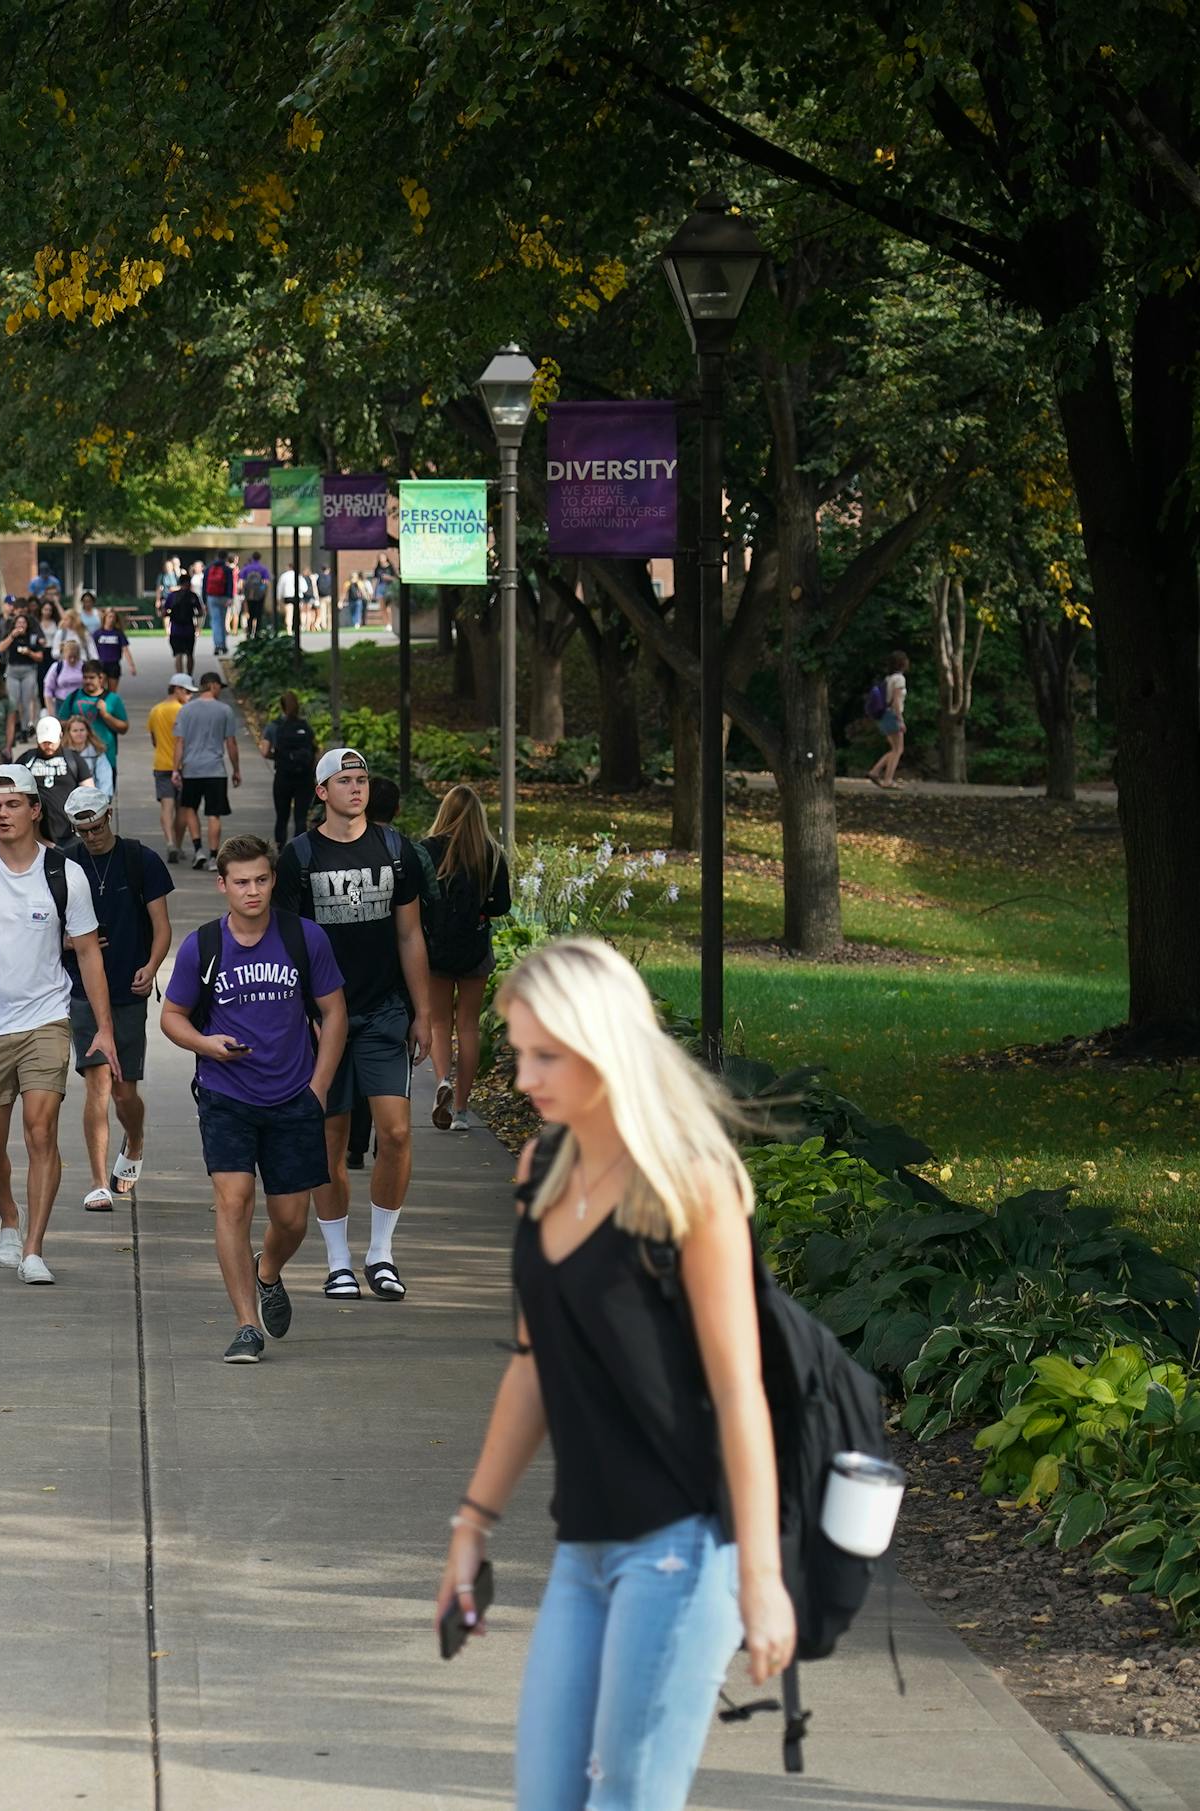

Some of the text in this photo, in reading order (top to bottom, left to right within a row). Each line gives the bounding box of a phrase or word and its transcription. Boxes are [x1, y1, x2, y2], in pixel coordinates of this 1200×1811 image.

[547, 459, 678, 481] DIVERSITY
[560, 484, 624, 495] WE STRIVE
[323, 494, 386, 506] PURSUIT
[560, 495, 639, 506] TO CREATE A
[323, 506, 388, 517] OF TRUTH
[401, 509, 486, 521] PERSONAL
[560, 506, 666, 517] VIBRANT DIVERSE
[401, 522, 487, 534] ATTENTION
[560, 518, 639, 528] COMMUNITY
[214, 962, 299, 994] ST. THOMAS
[243, 990, 294, 1002] TOMMIES
